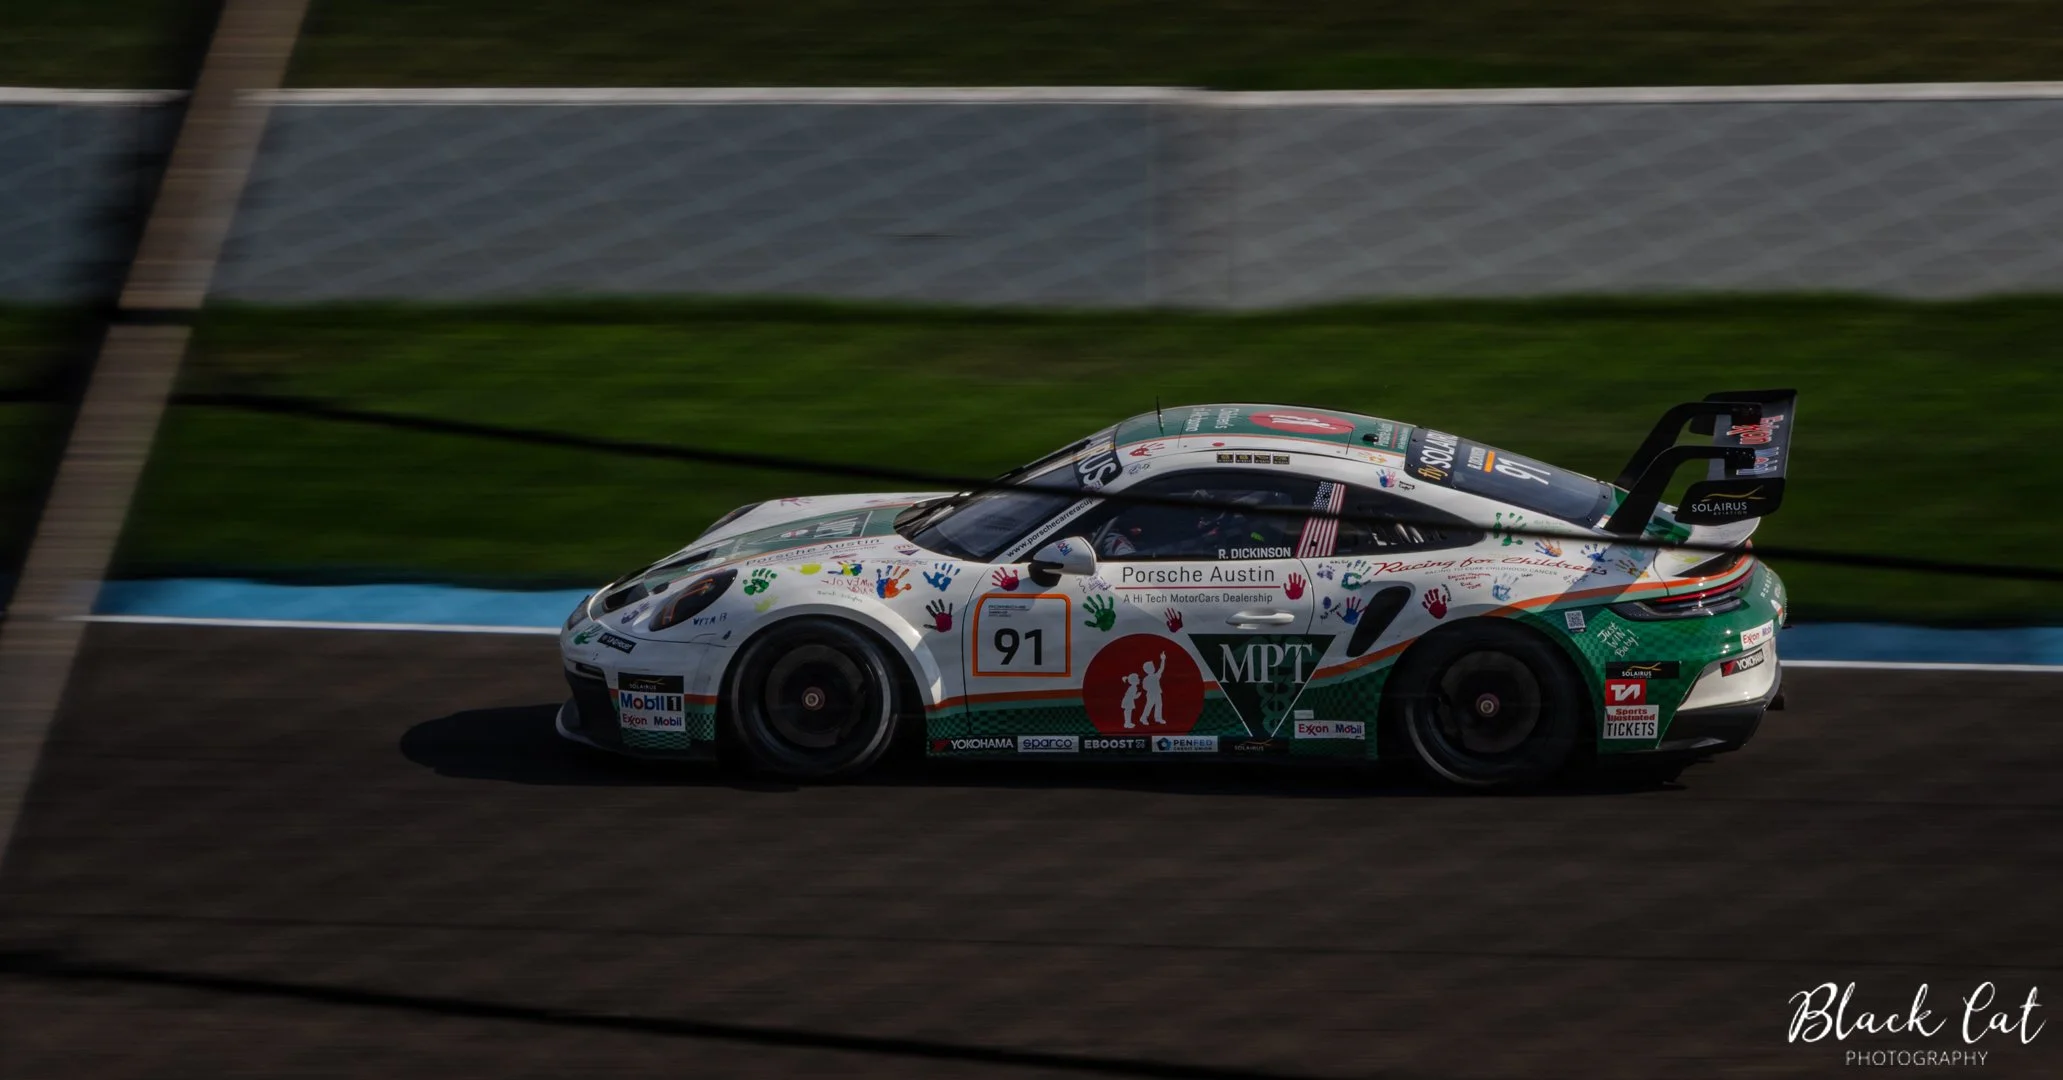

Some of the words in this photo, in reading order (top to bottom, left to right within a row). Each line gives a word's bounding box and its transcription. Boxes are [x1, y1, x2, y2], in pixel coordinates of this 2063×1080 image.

[1418, 464, 1448, 480] fly
[1494, 457, 1551, 486] 91
[1691, 501, 1748, 513] SOLAIRUS
[746, 547, 816, 567] Porsche
[823, 537, 881, 551] Austin
[1218, 549, 1229, 560] R.
[1231, 546, 1292, 559] DICKINSON
[1374, 559, 1452, 576] Racing
[1459, 557, 1493, 567] for
[1501, 557, 1607, 576] Children's
[1122, 566, 1203, 583] Porsche
[1209, 565, 1275, 582] Austin
[1123, 593, 1131, 603] A
[1133, 593, 1143, 603] Hi
[1146, 593, 1168, 603] Tech
[1170, 592, 1220, 603] MotorCars
[1222, 591, 1273, 604] Dealership
[993, 627, 1043, 666] 91
[1218, 643, 1314, 684] MPT
[621, 691, 665, 711] Mobil
[1615, 708, 1648, 716] Sports
[622, 713, 648, 727] Exxon
[654, 716, 682, 727] Mobil
[1298, 723, 1329, 736] Exxon
[1335, 725, 1362, 735] Mobil
[1607, 722, 1655, 736] TICKETS
[950, 738, 1015, 750] YOKOHAMA
[1022, 738, 1073, 749] sparco
[1084, 740, 1133, 749] EBOOST
